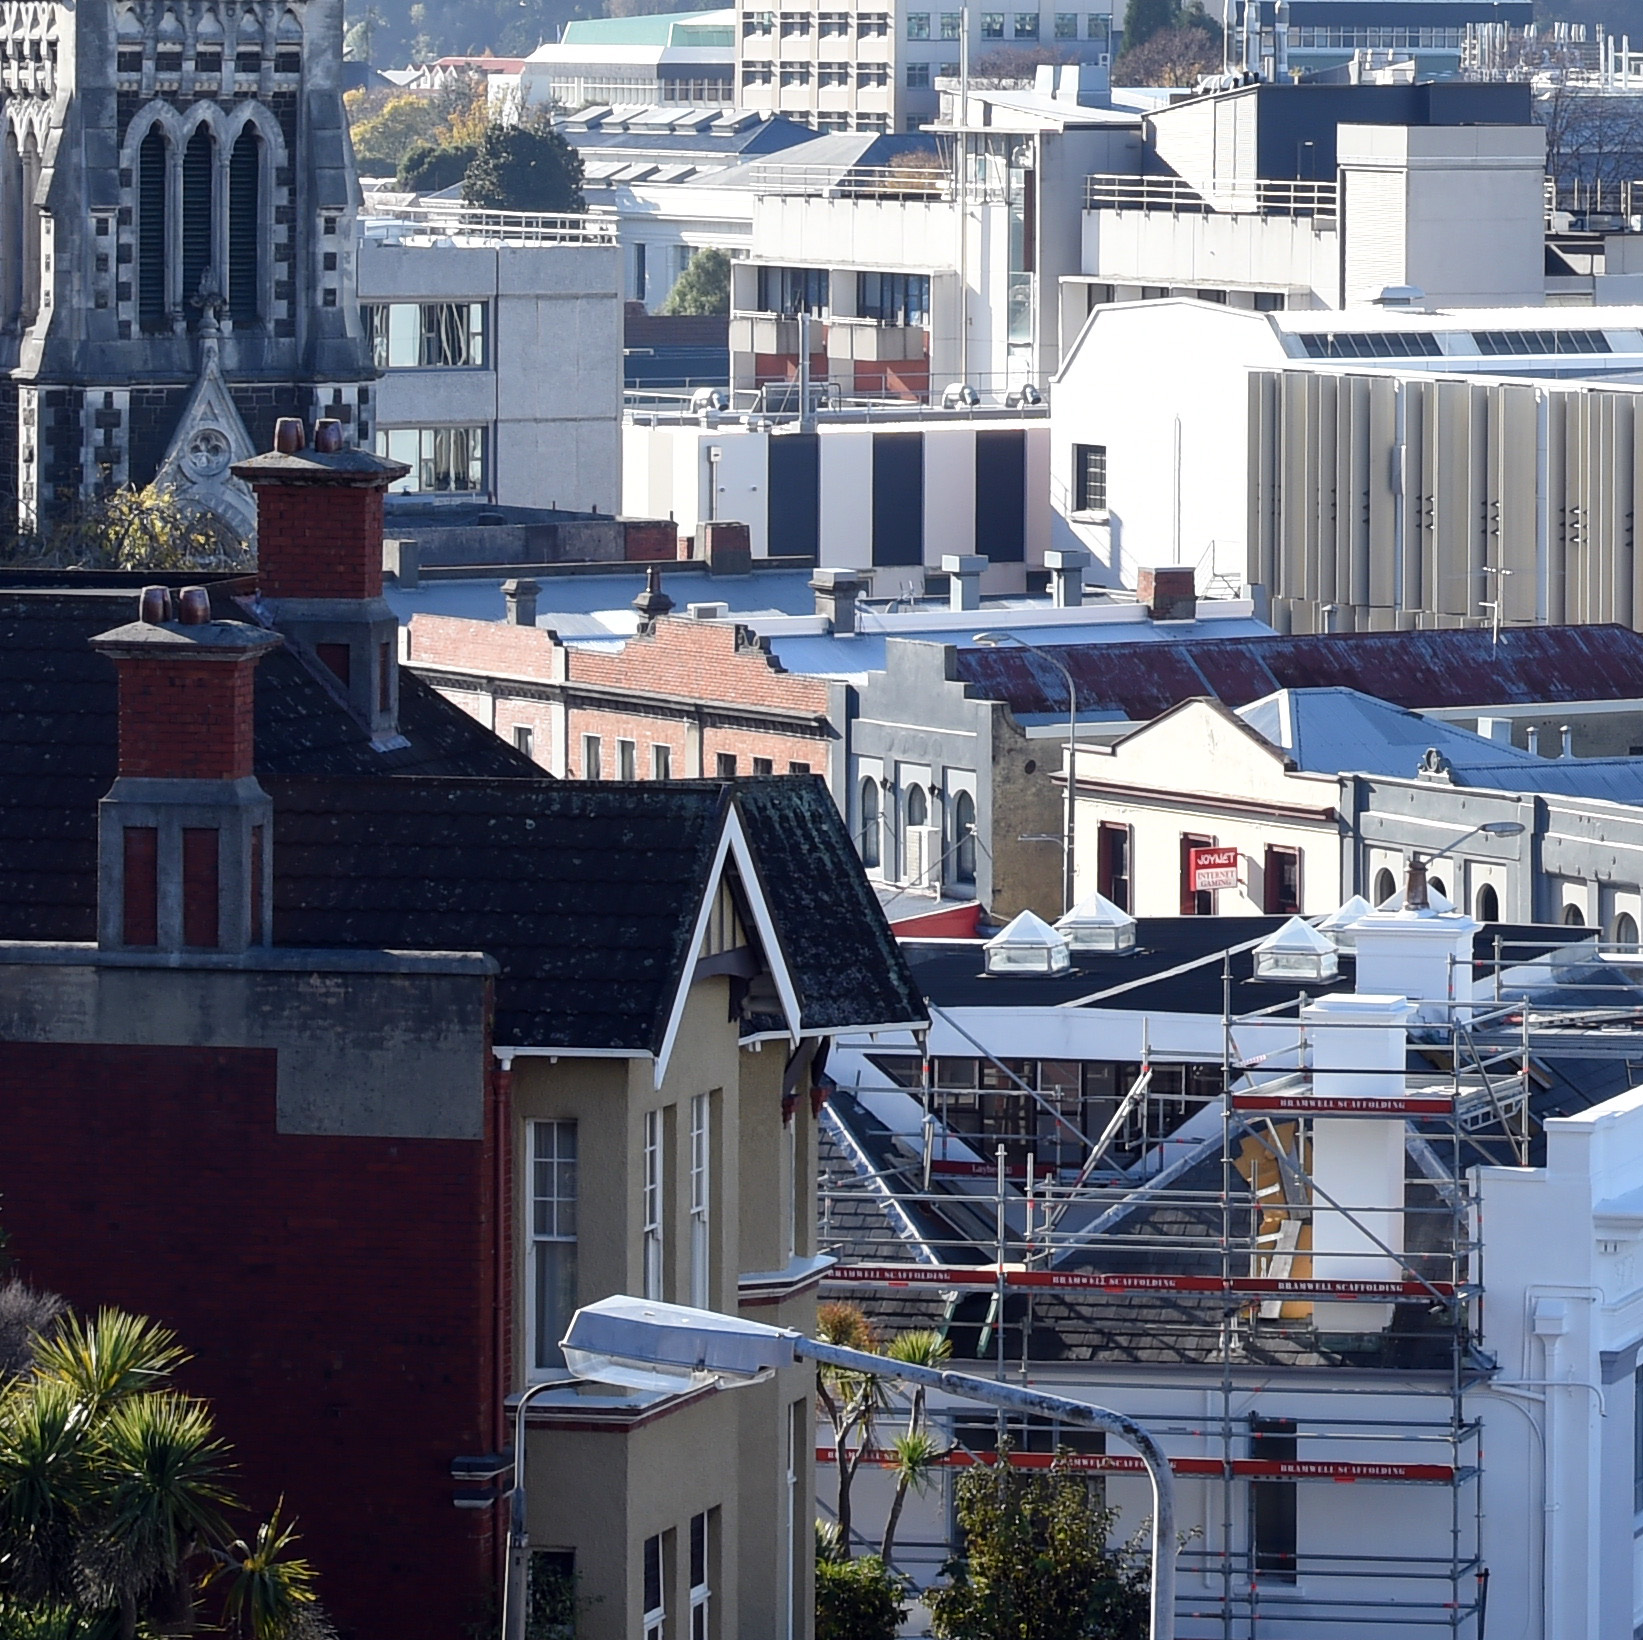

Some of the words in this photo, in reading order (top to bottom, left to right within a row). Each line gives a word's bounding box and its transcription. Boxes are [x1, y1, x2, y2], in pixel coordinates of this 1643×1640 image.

[1198, 871, 1234, 879] INTERNET
[1201, 879, 1232, 887] GAMING
[1279, 1099, 1335, 1108] BRAMWELL
[1337, 1100, 1406, 1109] SCAFFOLDING
[883, 1271, 951, 1280] SCAFFOLDING
[1052, 1276, 1106, 1286] BRAMWELL
[1108, 1278, 1177, 1287] SCAFFOLDING
[1277, 1281, 1332, 1291] BRAMWELL
[1335, 1283, 1404, 1292] SCAFFOLDING
[1280, 1464, 1334, 1474] BRAMWELL
[1337, 1465, 1406, 1475] SCAFFOLDING
